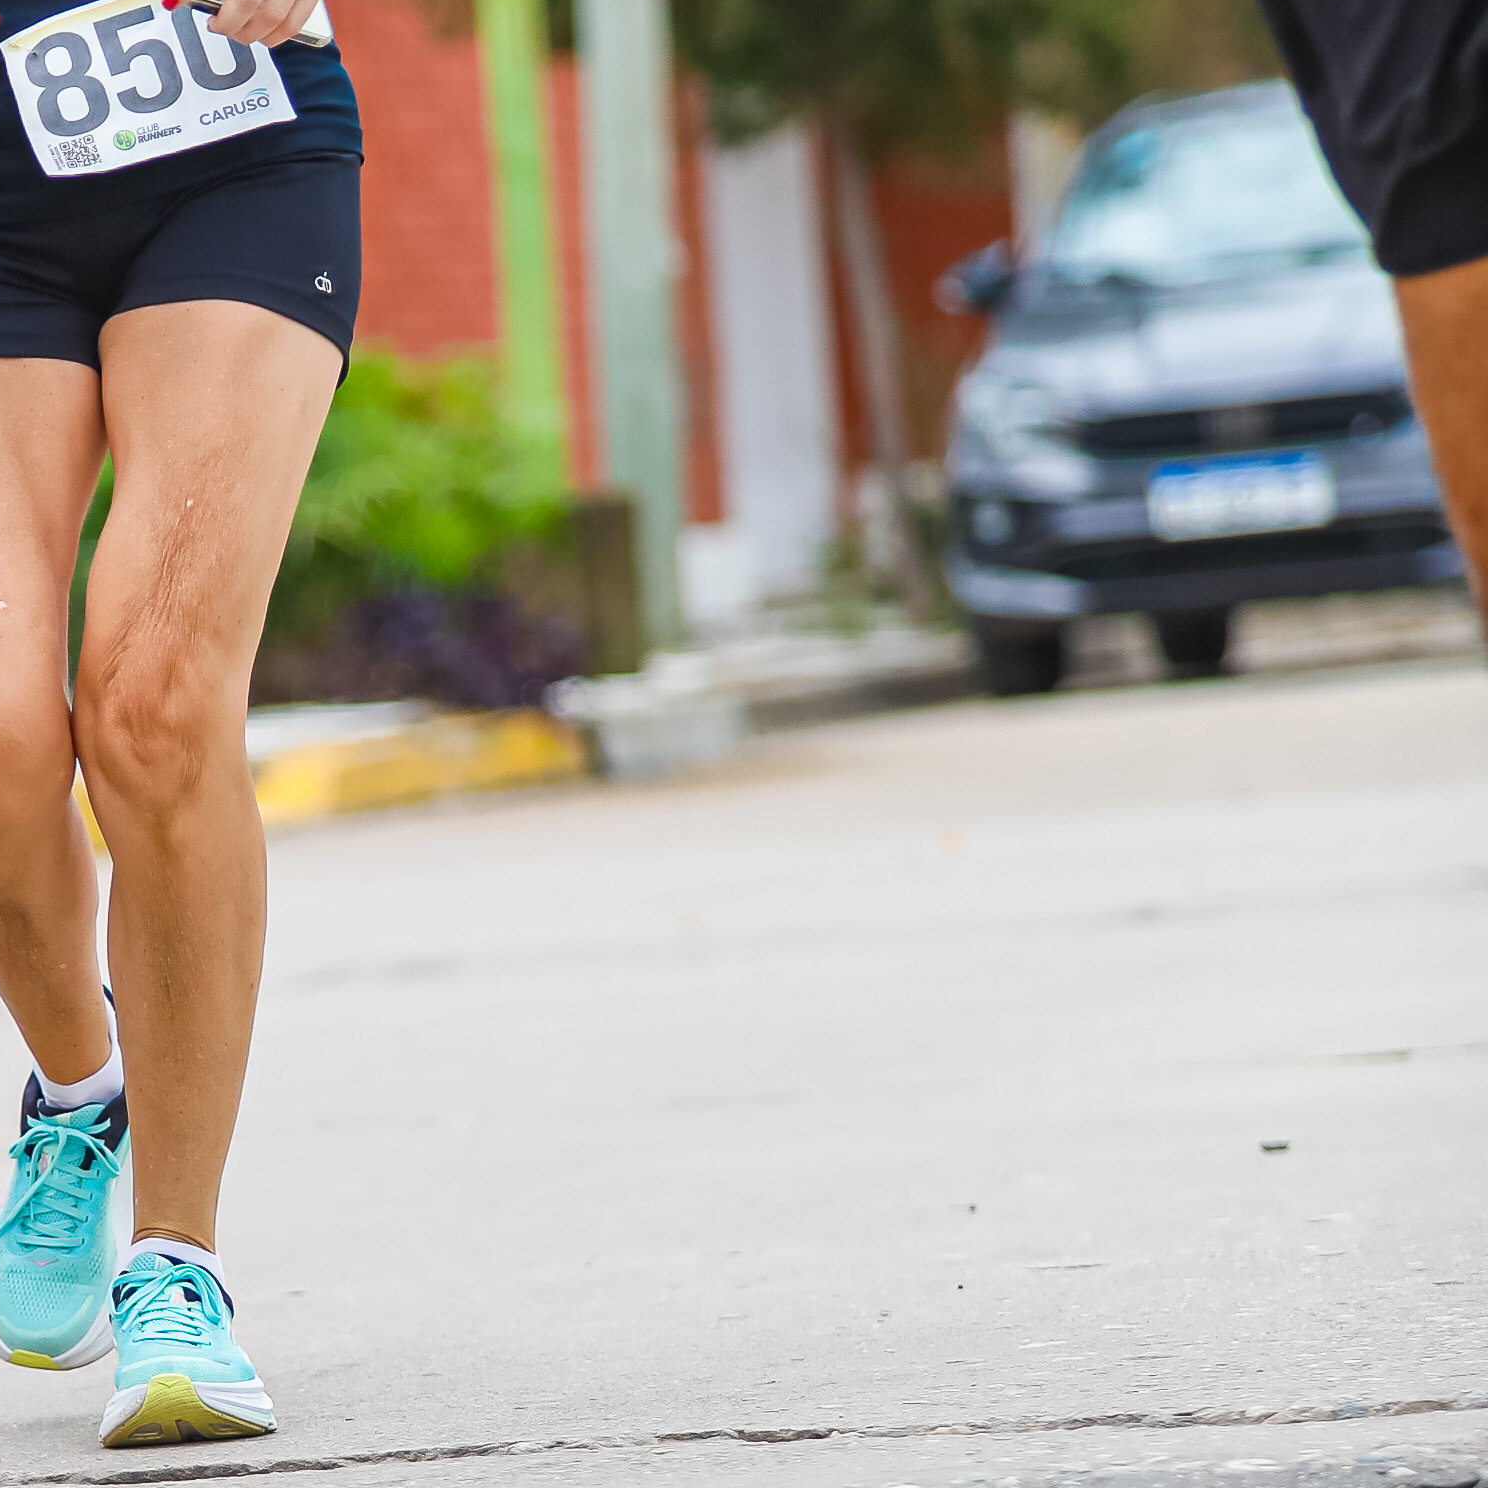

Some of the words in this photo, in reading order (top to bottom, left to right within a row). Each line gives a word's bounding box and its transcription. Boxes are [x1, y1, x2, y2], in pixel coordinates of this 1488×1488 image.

[25, 5, 257, 137] 850
[199, 97, 270, 126] CARUSO
[136, 122, 160, 135] CLUB
[137, 125, 182, 143] RUNNER'S
